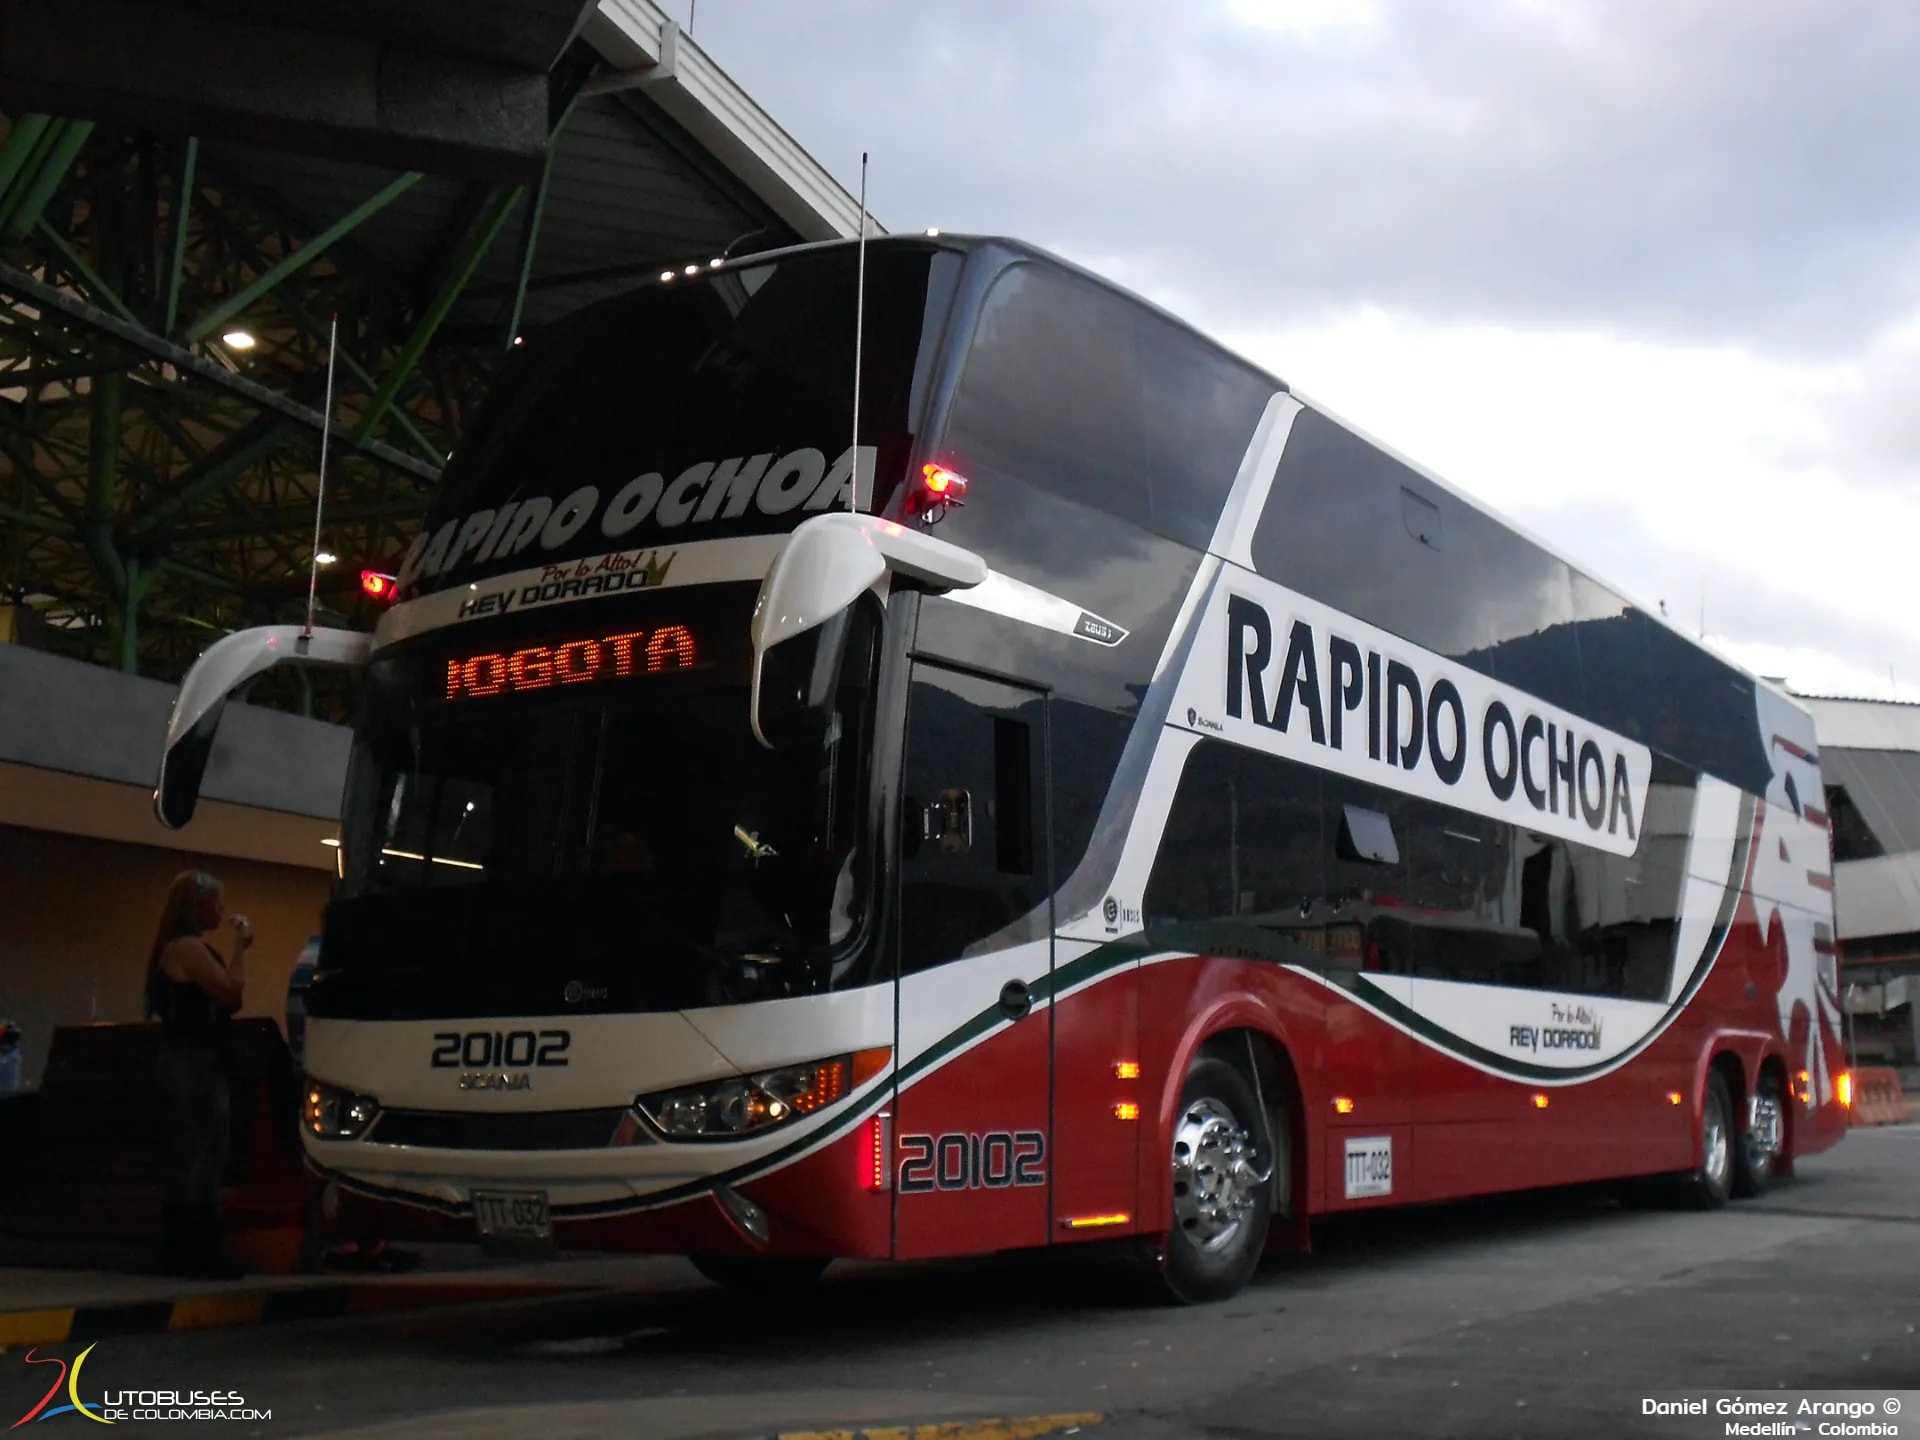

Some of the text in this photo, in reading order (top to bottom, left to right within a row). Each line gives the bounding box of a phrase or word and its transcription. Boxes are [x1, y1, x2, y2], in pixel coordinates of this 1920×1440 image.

[601, 446, 877, 537] OCHOA
[540, 551, 644, 583] Por lo Alto!
[518, 570, 649, 605] DORADO
[1226, 593, 1636, 841] RAPIDO OCHOA
[431, 1030, 571, 1068] 20102
[1510, 1025, 1596, 1054] REY DORADO
[459, 1072, 534, 1091] SCANIA
[898, 1131, 1045, 1194] 20102
[1347, 1151, 1390, 1182] TTT-032
